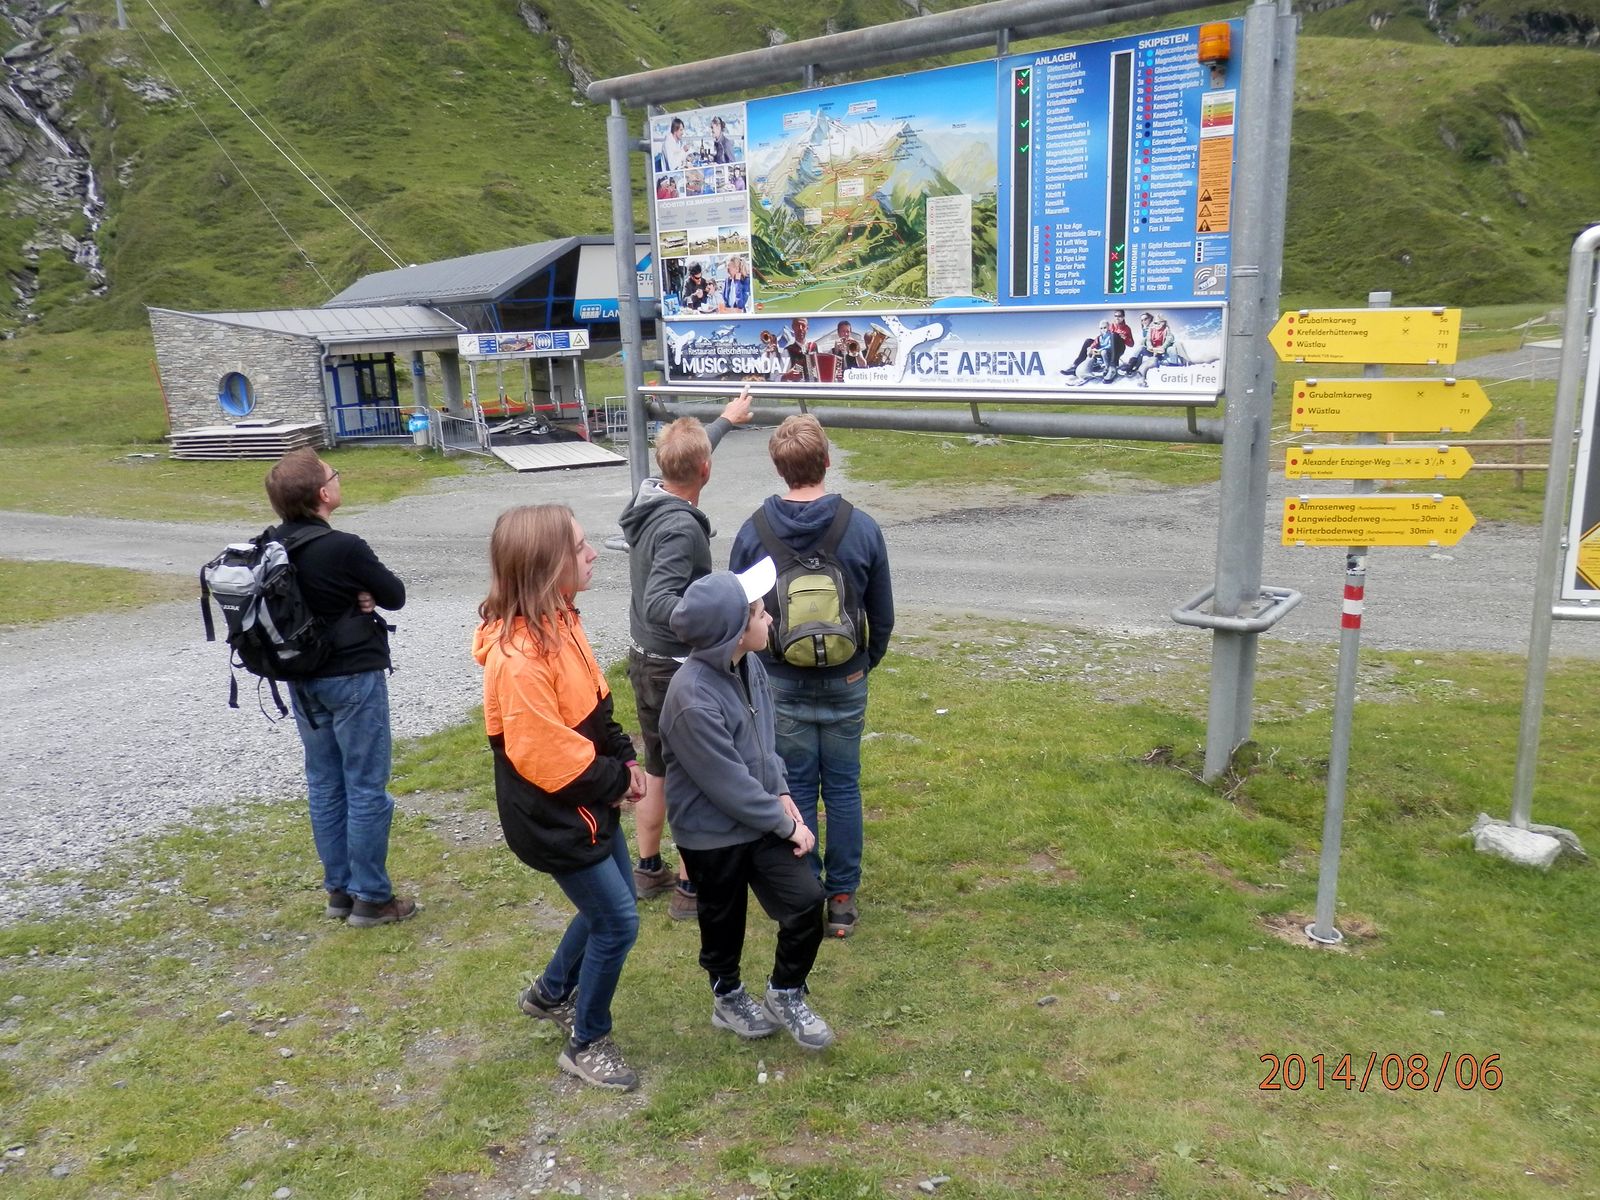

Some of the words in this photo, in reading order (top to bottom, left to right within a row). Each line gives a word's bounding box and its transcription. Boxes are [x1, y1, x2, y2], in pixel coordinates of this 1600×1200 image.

[1139, 33, 1189, 49] SKIPISTEN
[1035, 52, 1076, 66] ANLAGEN
[1298, 316, 1357, 326] Grubalmkarweg
[1297, 328, 1368, 337] Krefelderhüttenweg
[1296, 340, 1326, 348] Wüstlau
[682, 357, 728, 373] MUSIC
[732, 357, 790, 374] SUNDAY
[910, 351, 948, 375] ICE
[957, 351, 1046, 376] ARENA
[848, 372, 868, 381] Gratis
[873, 372, 888, 381] Free
[1160, 373, 1188, 384] Gratis
[1196, 373, 1217, 383] Free
[1309, 391, 1372, 400] Grubalmkarweg
[1308, 406, 1341, 415] Wüstlau
[1302, 458, 1339, 466] Alexander
[1341, 458, 1391, 467] Enzinger-Weg
[1298, 503, 1356, 512] Almrosenweg
[1297, 515, 1380, 524] Langwiedbodenweg
[1296, 527, 1364, 536] Hirterbodenweg
